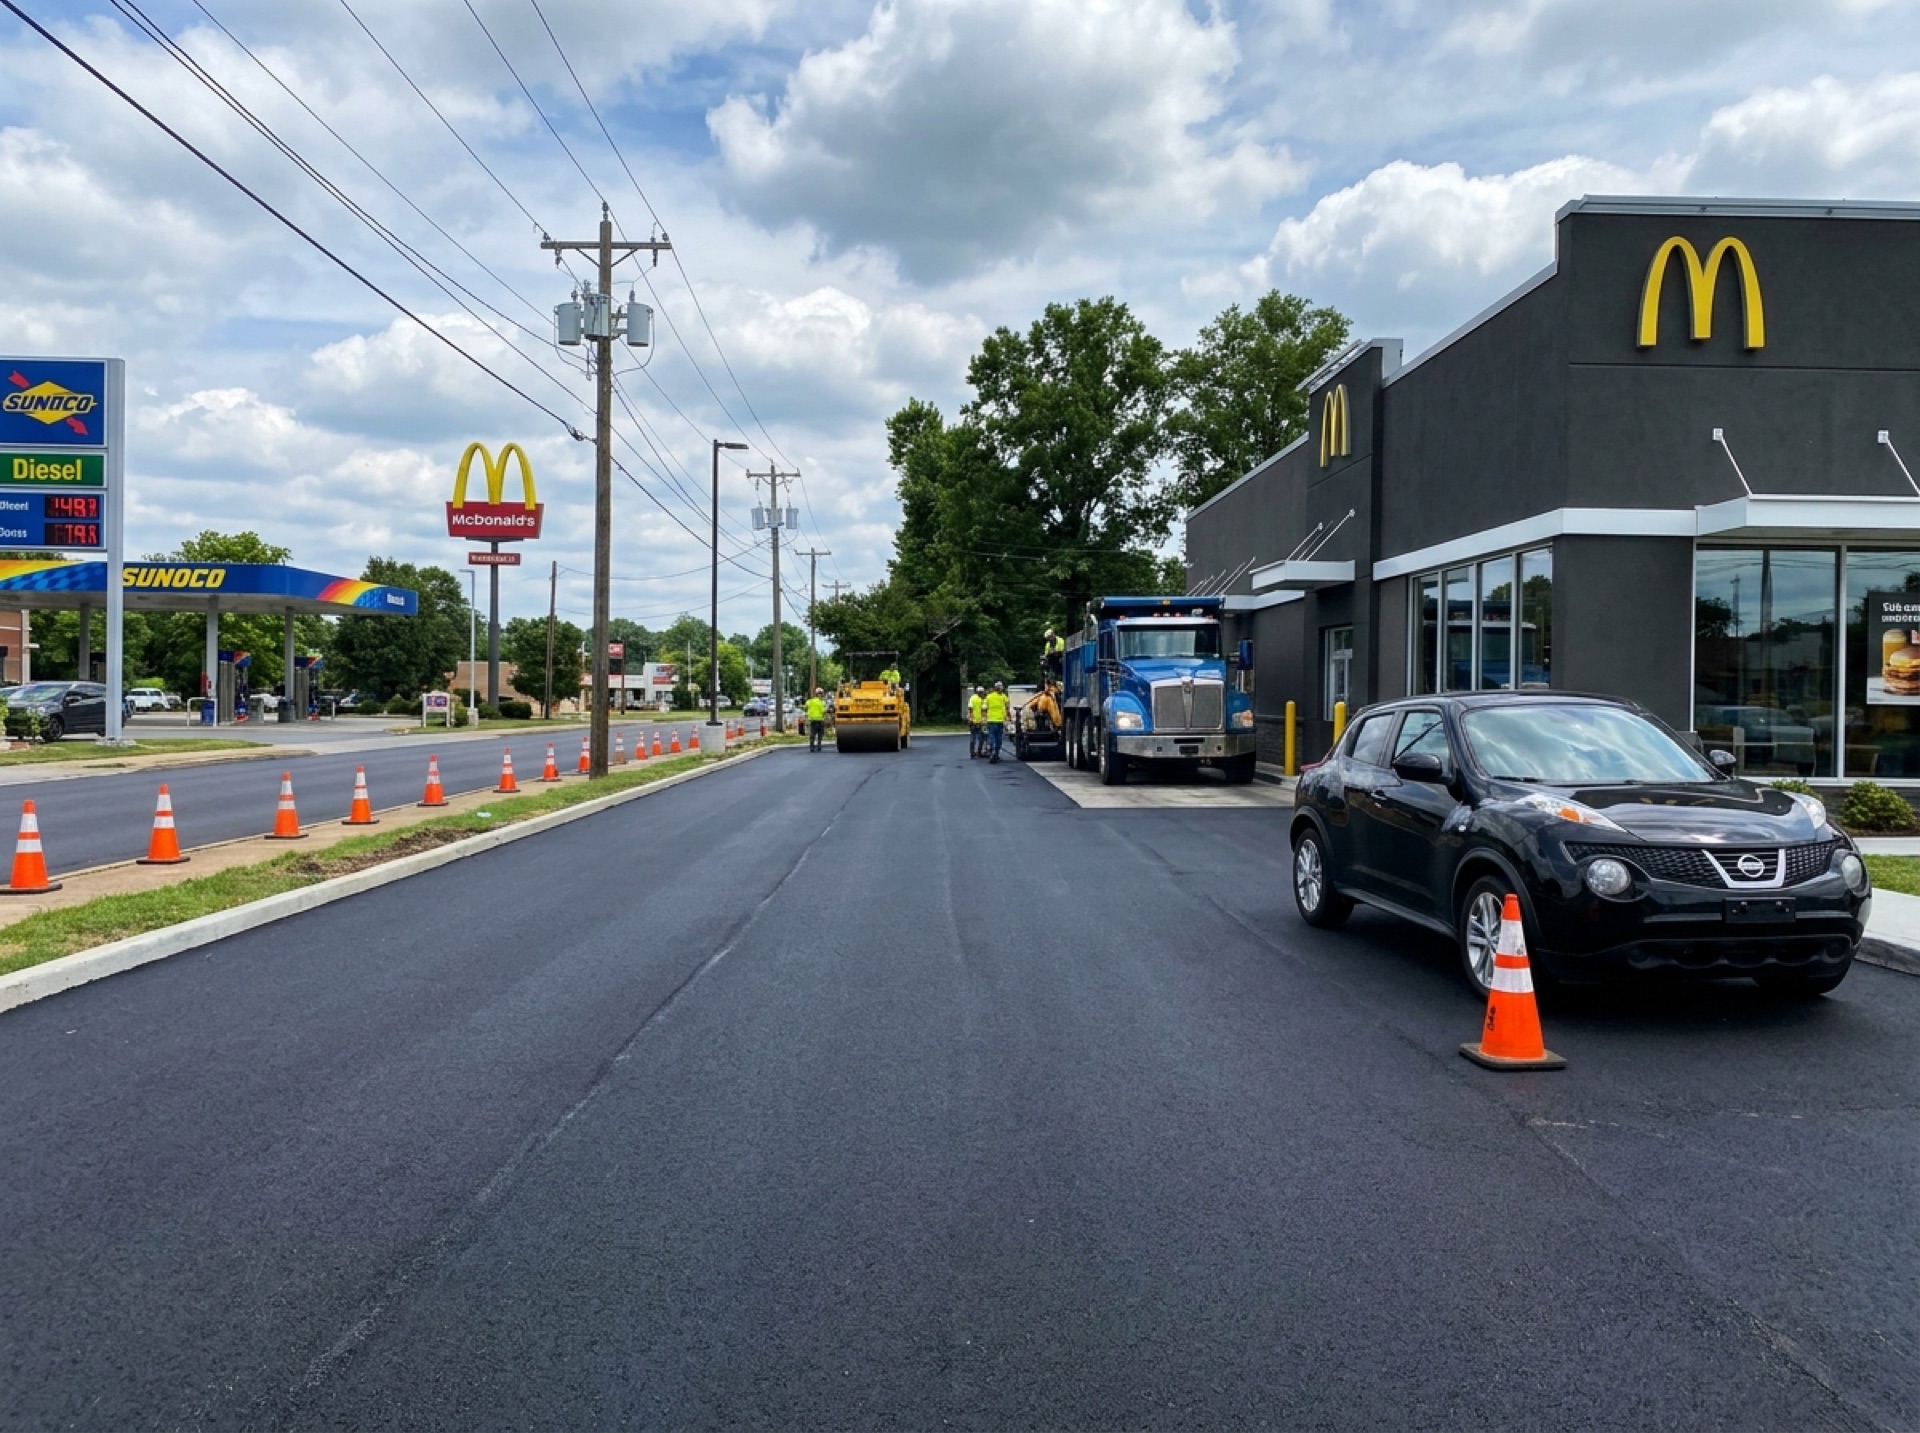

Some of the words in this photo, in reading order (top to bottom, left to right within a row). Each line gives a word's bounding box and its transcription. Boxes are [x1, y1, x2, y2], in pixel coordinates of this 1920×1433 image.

[5, 394, 92, 412] SUNOCO
[13, 458, 82, 480] Diesel
[122, 567, 226, 588] SUNOCO
